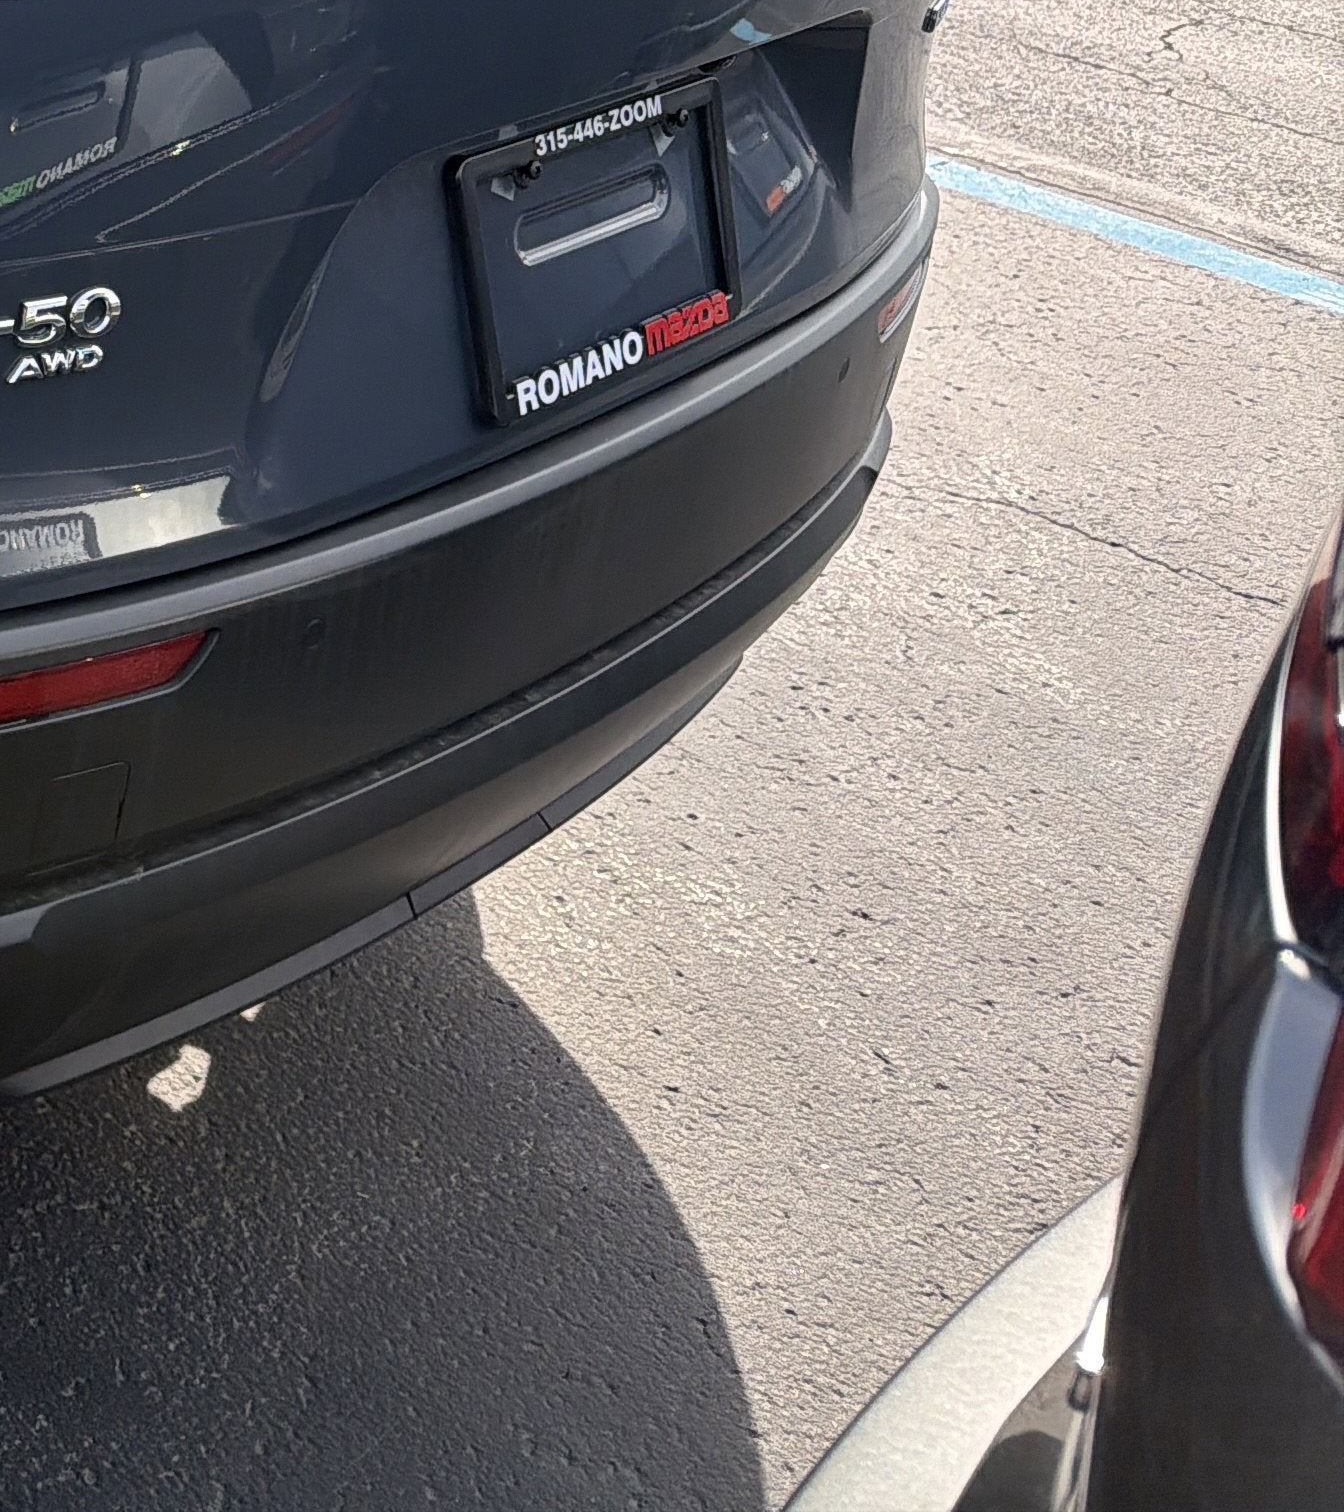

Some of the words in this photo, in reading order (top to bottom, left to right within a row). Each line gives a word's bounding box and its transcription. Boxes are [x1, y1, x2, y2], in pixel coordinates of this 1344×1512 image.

[534, 94, 663, 157] 315-446-ZOOM
[4, 344, 105, 385] AWD
[516, 330, 645, 416] ROMANO
[642, 289, 732, 357] mazda
